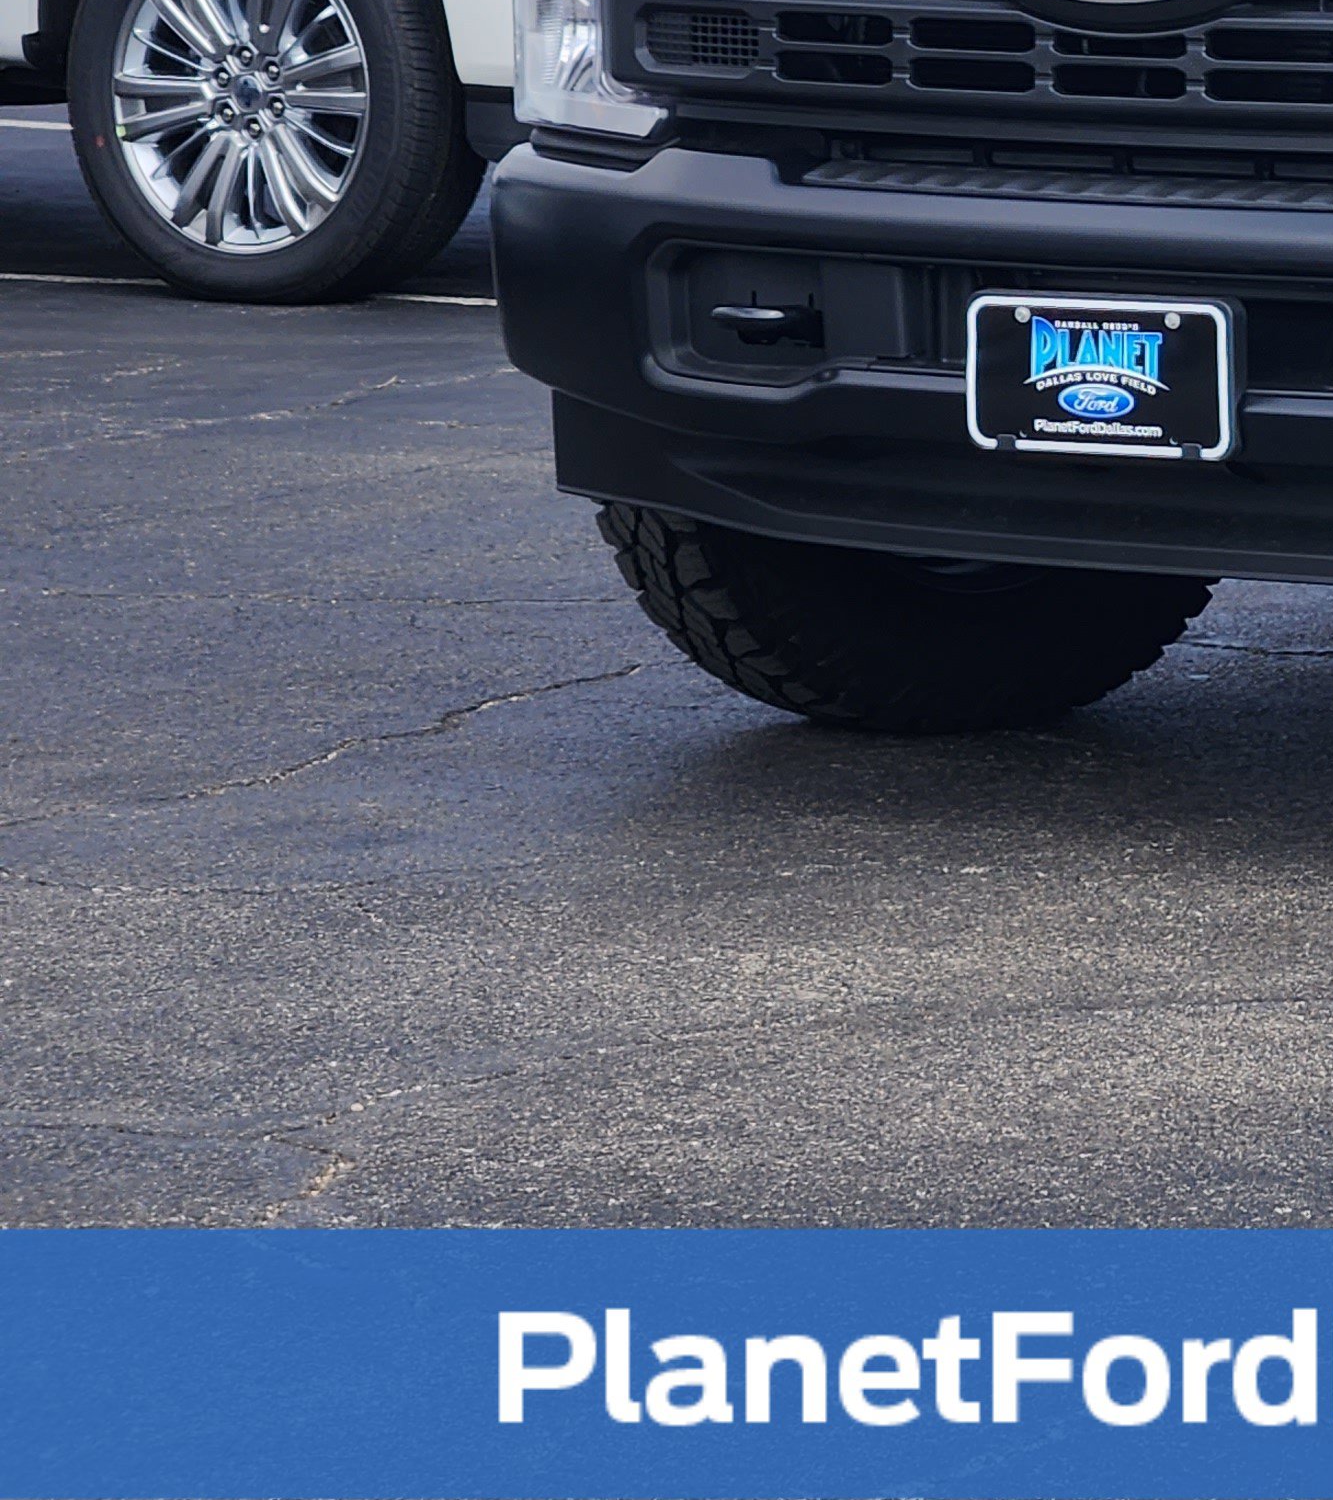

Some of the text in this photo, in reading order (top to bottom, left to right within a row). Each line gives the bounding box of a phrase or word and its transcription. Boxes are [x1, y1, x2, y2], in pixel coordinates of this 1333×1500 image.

[1031, 316, 1163, 380] PLANET
[1036, 372, 1157, 395] DALLAS LOVE FIELD
[1073, 389, 1119, 412] Ford
[1034, 418, 1162, 438] PlanetFordDallas.com
